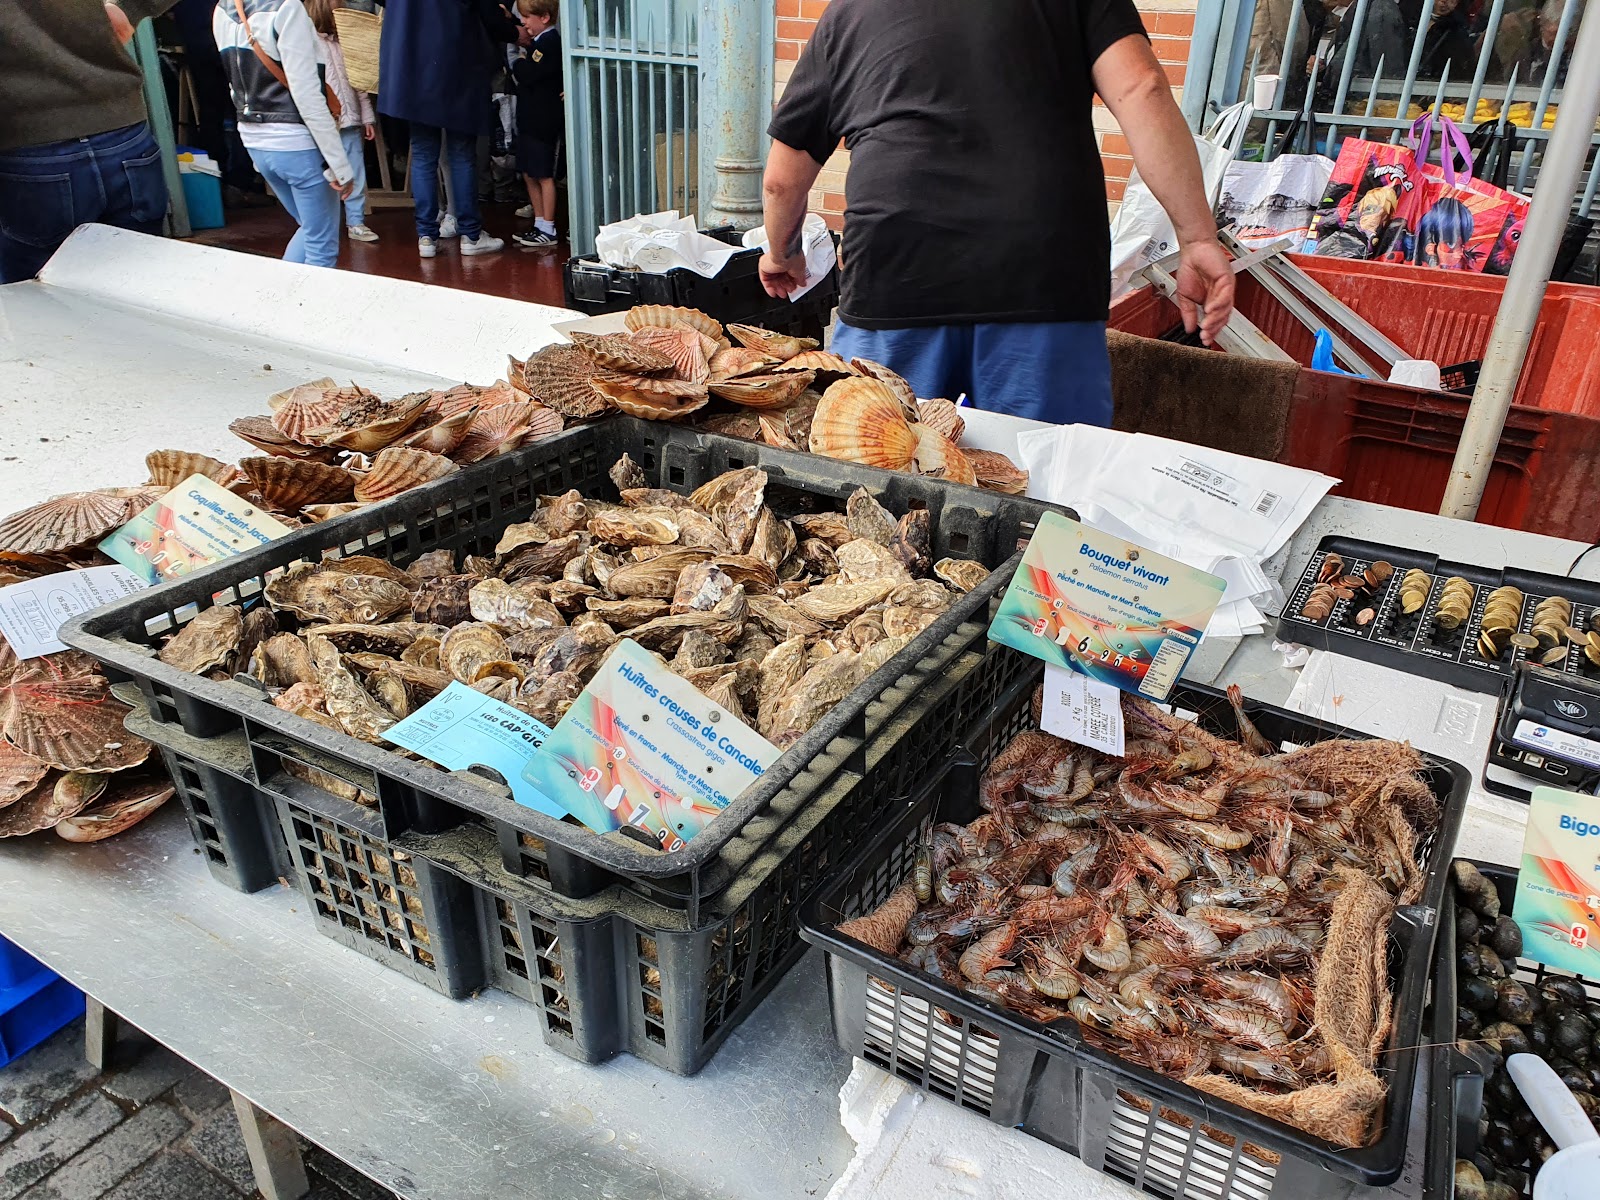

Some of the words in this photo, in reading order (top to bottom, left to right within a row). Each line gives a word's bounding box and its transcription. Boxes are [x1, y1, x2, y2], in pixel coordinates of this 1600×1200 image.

[188, 490, 225, 516] Coquilles
[197, 526, 215, 539] Manche
[219, 540, 231, 549] Mers
[1079, 543, 1131, 571] Bouquet
[1133, 565, 1169, 586] vivant
[1088, 562, 1121, 580] Palaemon
[1122, 576, 1149, 590] serratus
[80, 571, 99, 596] COQUILLES
[111, 571, 131, 595] LAURENT
[1015, 585, 1027, 593] Zone
[1028, 588, 1034, 596] de
[1035, 592, 1050, 601] pêche
[1057, 572, 1075, 585] Pêché
[1085, 583, 1110, 597] Manche
[1118, 596, 1133, 607] Mers
[1134, 602, 1162, 618] Celtiques
[1066, 605, 1091, 618] Sous-zone
[1098, 616, 1112, 625] pêche
[1107, 605, 1118, 613] Type
[1119, 609, 1135, 620] d'engin
[1142, 619, 1158, 628] pêche
[1292, 614, 1311, 623] CENT
[1337, 626, 1356, 635] CENT
[1378, 636, 1396, 645] CENT
[1421, 647, 1440, 656] CENT
[1467, 658, 1488, 667] CENT
[617, 662, 659, 698] Huîtres
[659, 695, 701, 730] creuses
[701, 726, 717, 742] de
[496, 705, 521, 720] Huîtres
[521, 718, 531, 726] de
[570, 716, 585, 730] Zone
[585, 727, 593, 736] de
[592, 733, 609, 748] pêche
[666, 717, 706, 751] Crassostrea
[705, 748, 726, 766] gigas
[613, 748, 623, 759] 18
[613, 715, 630, 731] Élevé
[629, 730, 638, 738] en
[638, 734, 657, 753] France
[661, 752, 688, 775] Manche
[688, 773, 697, 781] et
[696, 778, 713, 794] Mers
[580, 777, 592, 790] kg
[626, 757, 653, 779] Sous-zone
[653, 777, 661, 786] de
[660, 783, 677, 797] pêche
[675, 770, 687, 782] Type
[687, 780, 706, 797] d'engin
[705, 794, 713, 802] de
[1525, 882, 1544, 893] Zone
[1545, 887, 1555, 895] de
[1556, 890, 1579, 901] pêche
[1570, 937, 1584, 949] kg
